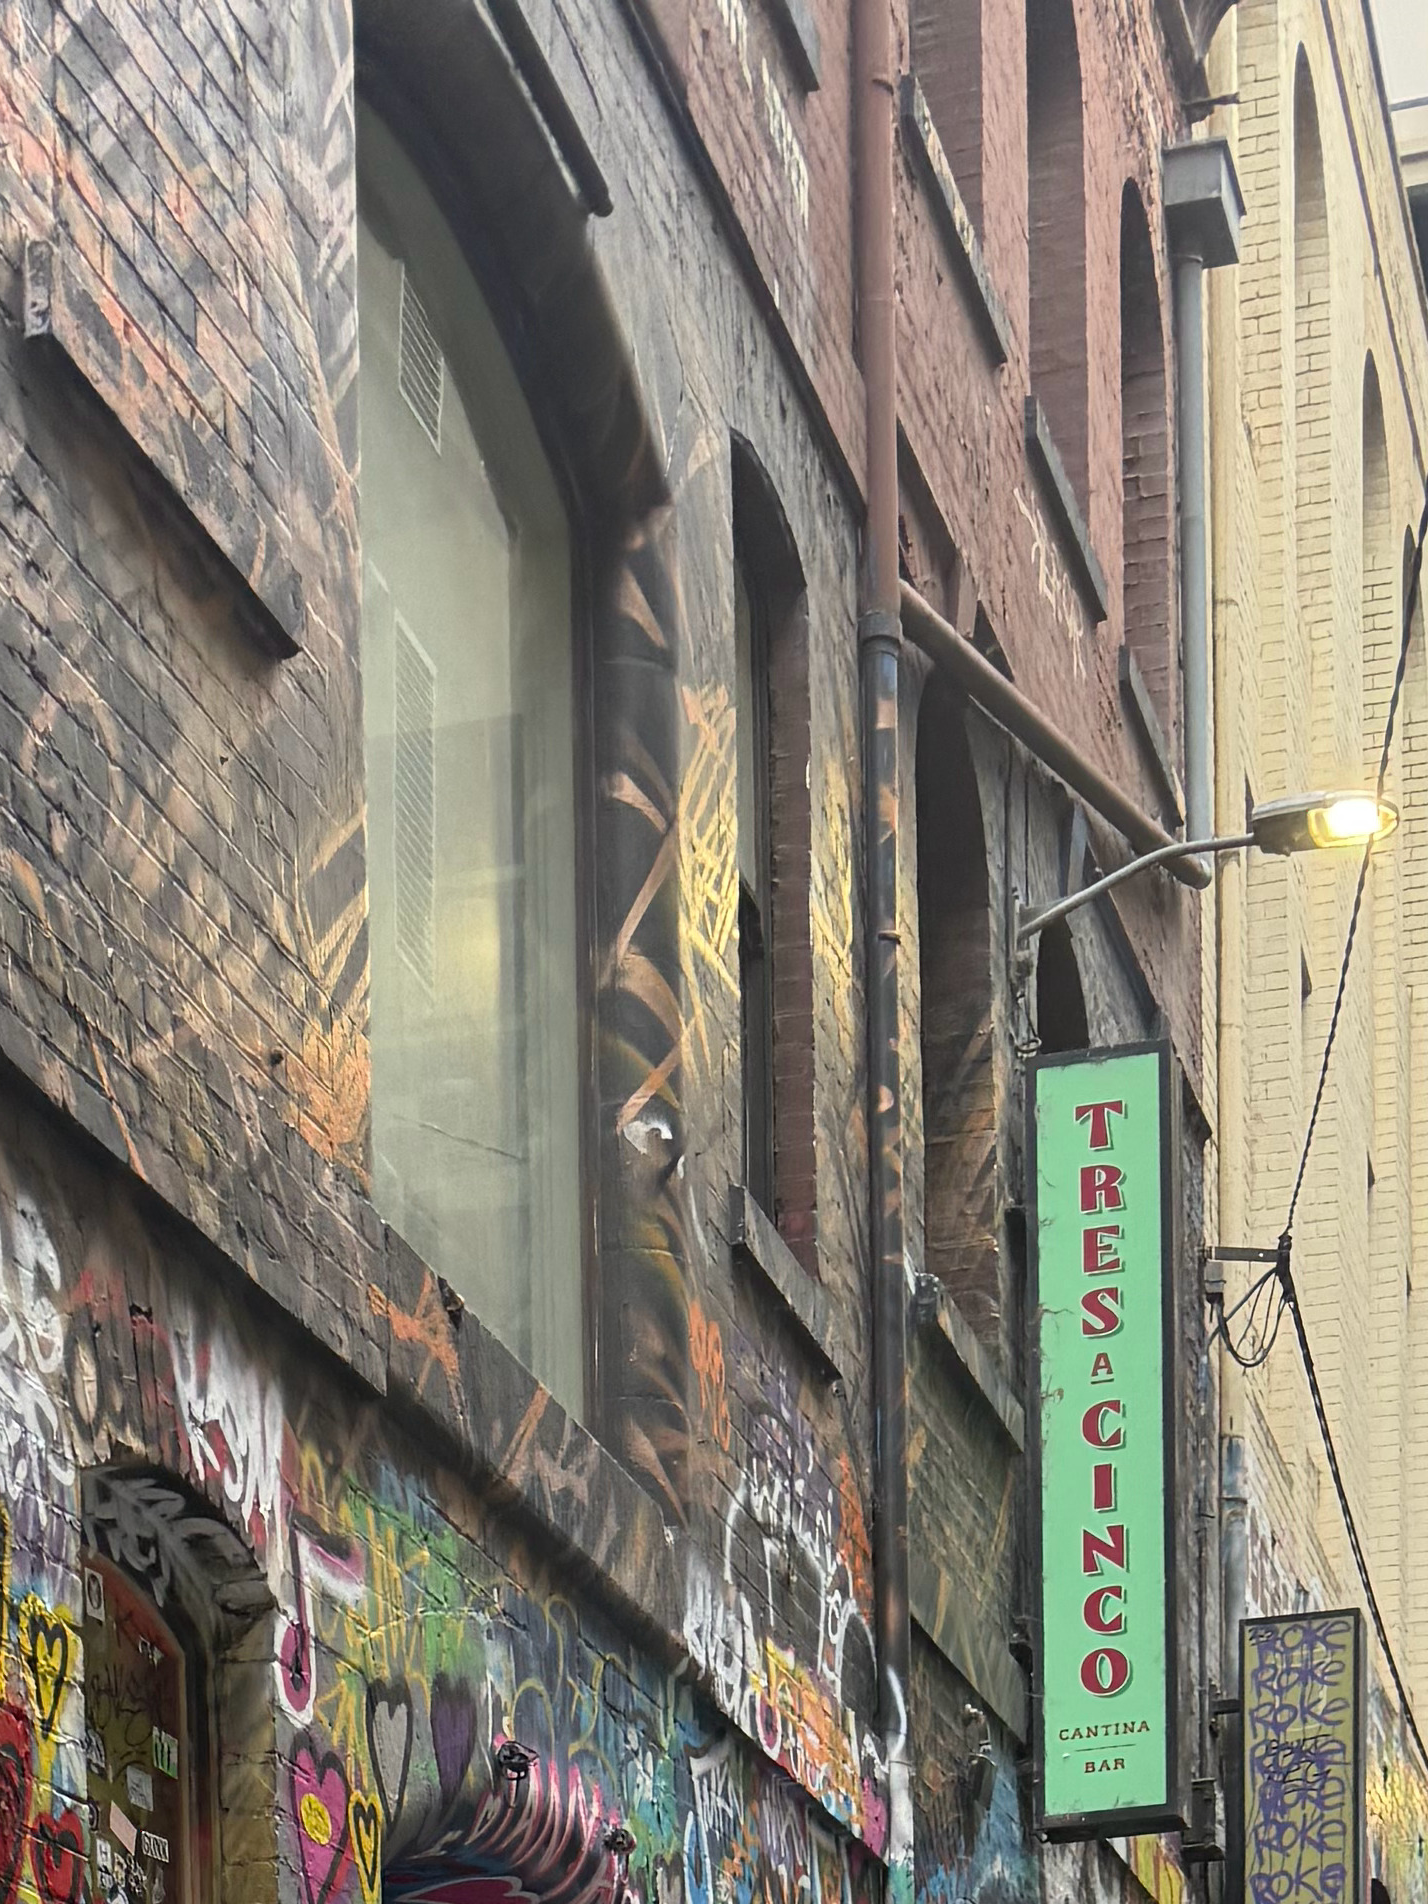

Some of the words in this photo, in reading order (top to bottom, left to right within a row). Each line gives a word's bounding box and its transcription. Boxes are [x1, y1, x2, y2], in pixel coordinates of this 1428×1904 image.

[1074, 1099, 1127, 1339] TRES
[1080, 1399, 1132, 1699] CINCO
[1058, 1719, 1151, 1742] CANTINA
[1083, 1757, 1126, 1774] BAR
